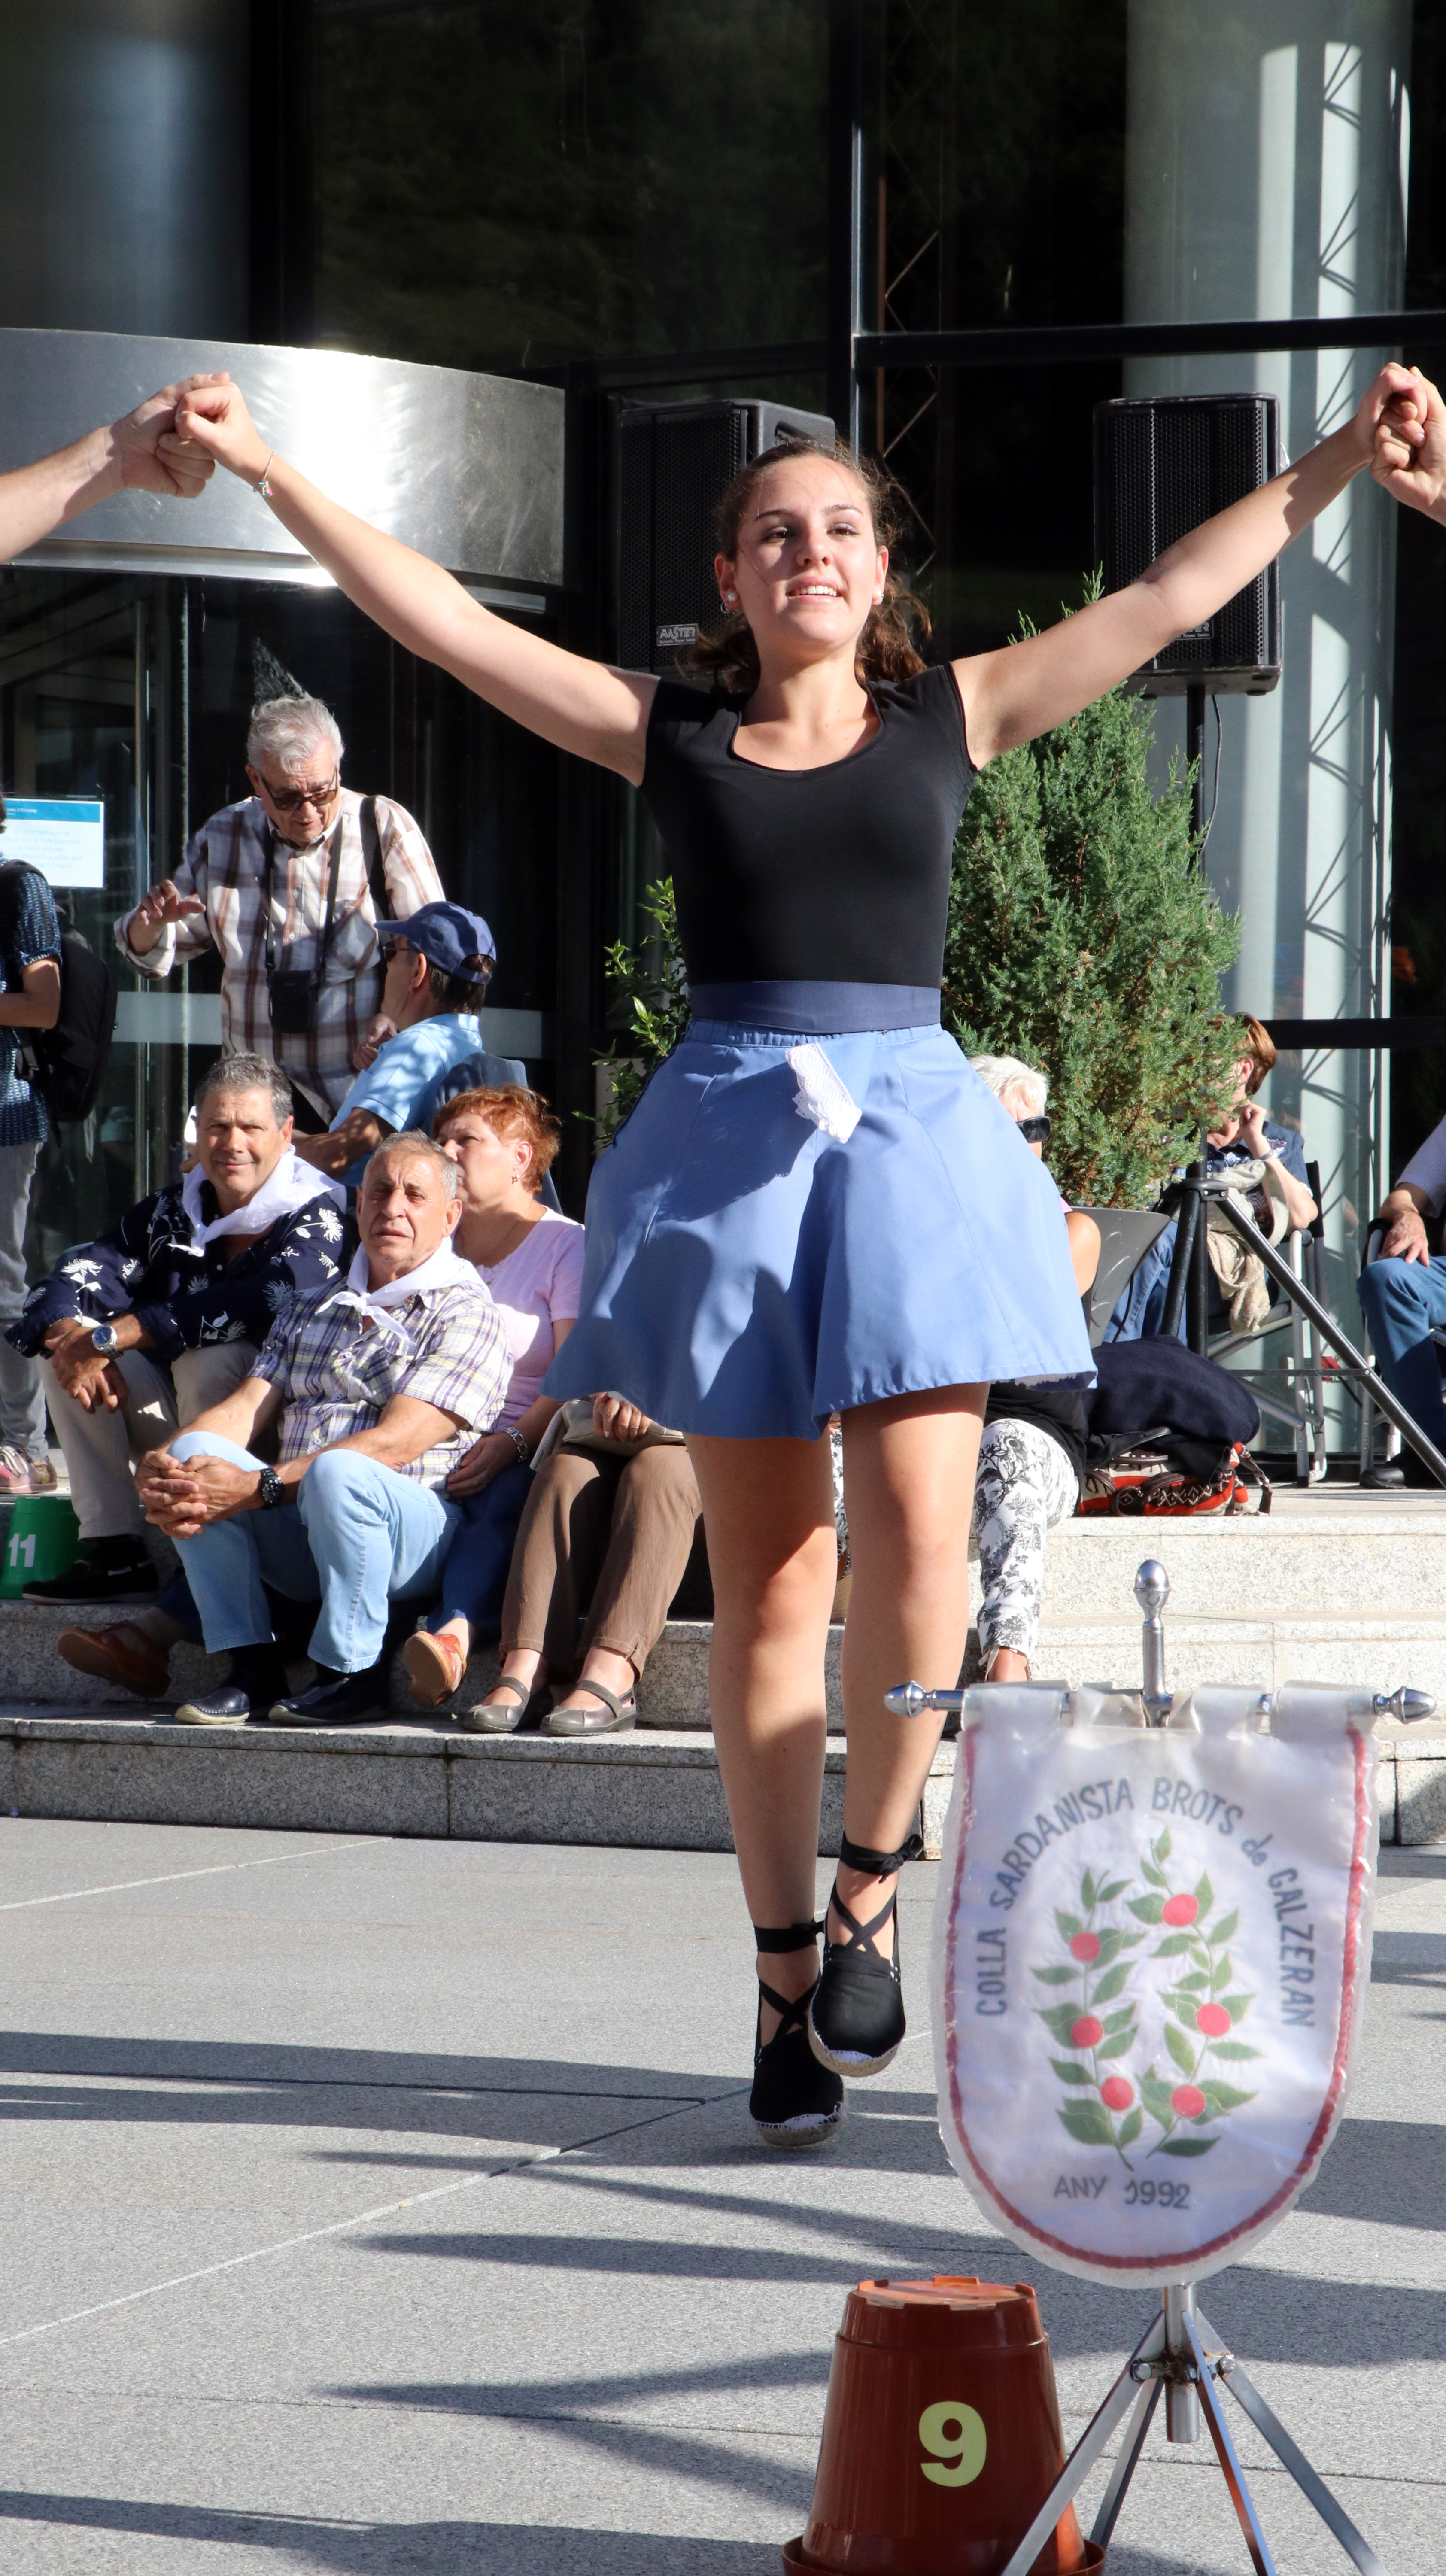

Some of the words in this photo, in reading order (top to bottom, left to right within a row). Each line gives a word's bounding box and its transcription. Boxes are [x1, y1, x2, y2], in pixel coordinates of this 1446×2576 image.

[9, 1533, 36, 1567] 11
[1151, 1777, 1243, 1836] BROTS
[989, 1777, 1135, 1911] SARDANISTA
[1241, 1833, 1273, 1867] de
[975, 1927, 1007, 2016] COLLA
[1054, 2175, 1108, 2199] ANY
[1124, 2179, 1191, 2210] 1992
[919, 2401, 987, 2487] 9
